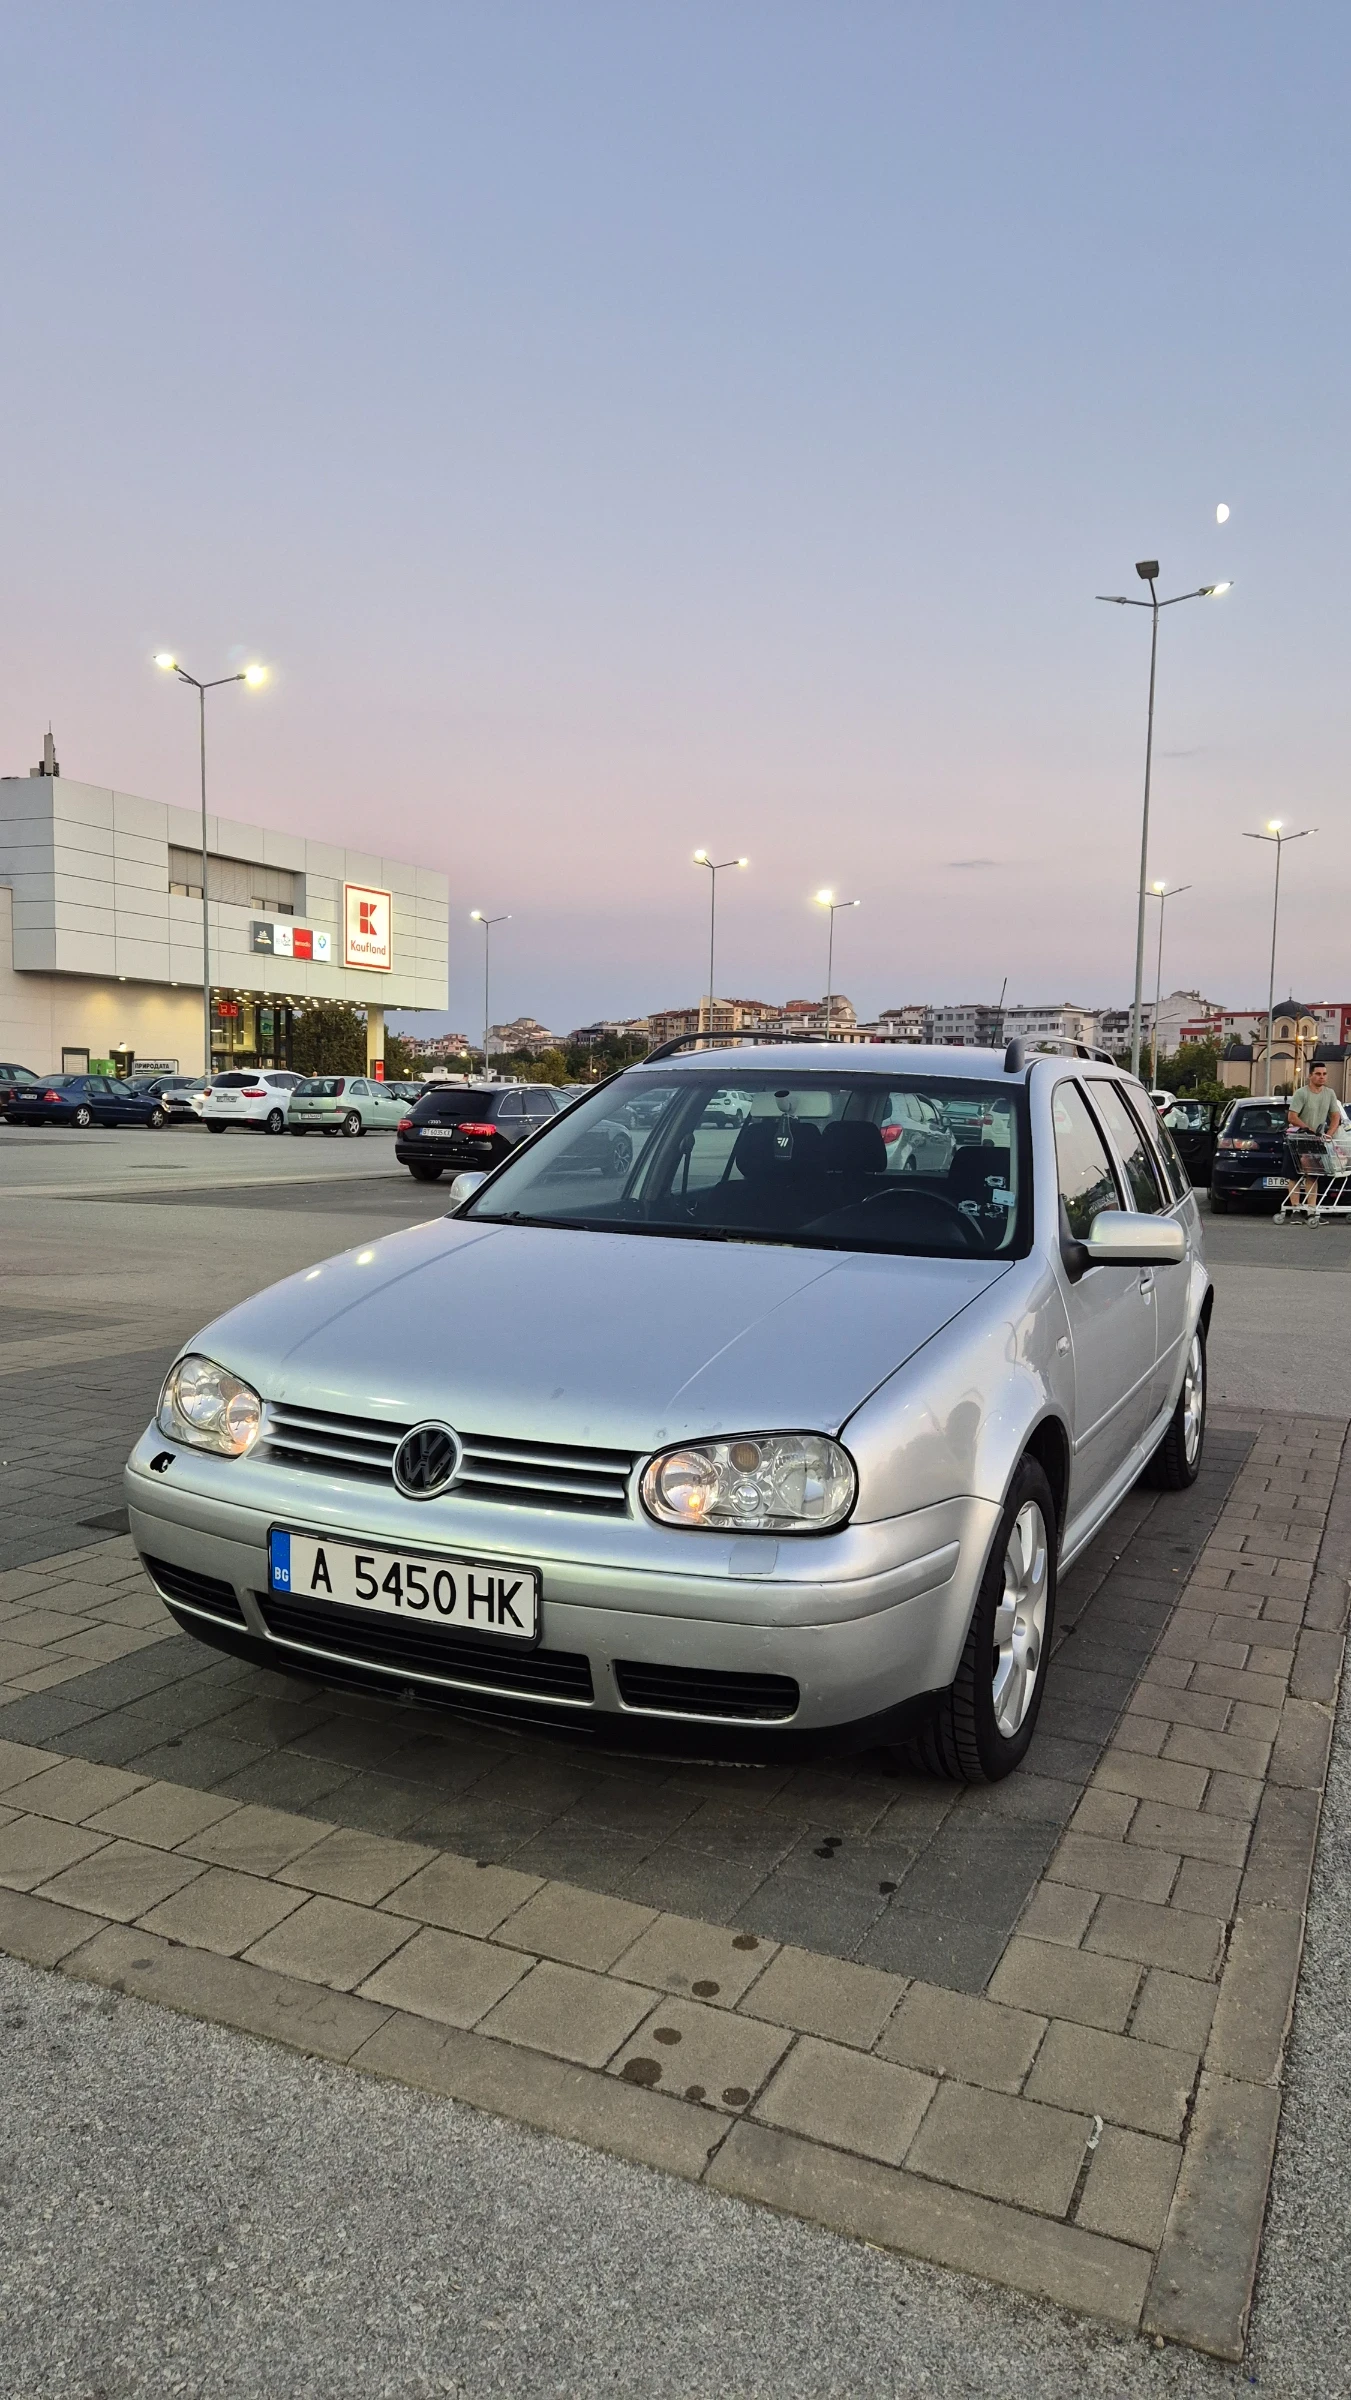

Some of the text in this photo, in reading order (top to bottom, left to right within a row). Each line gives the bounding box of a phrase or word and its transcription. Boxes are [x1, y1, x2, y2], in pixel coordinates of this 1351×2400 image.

[350, 940, 386, 955] Kaufland
[274, 1567, 289, 1582] BG
[310, 1548, 525, 1628] A 5450 HK
